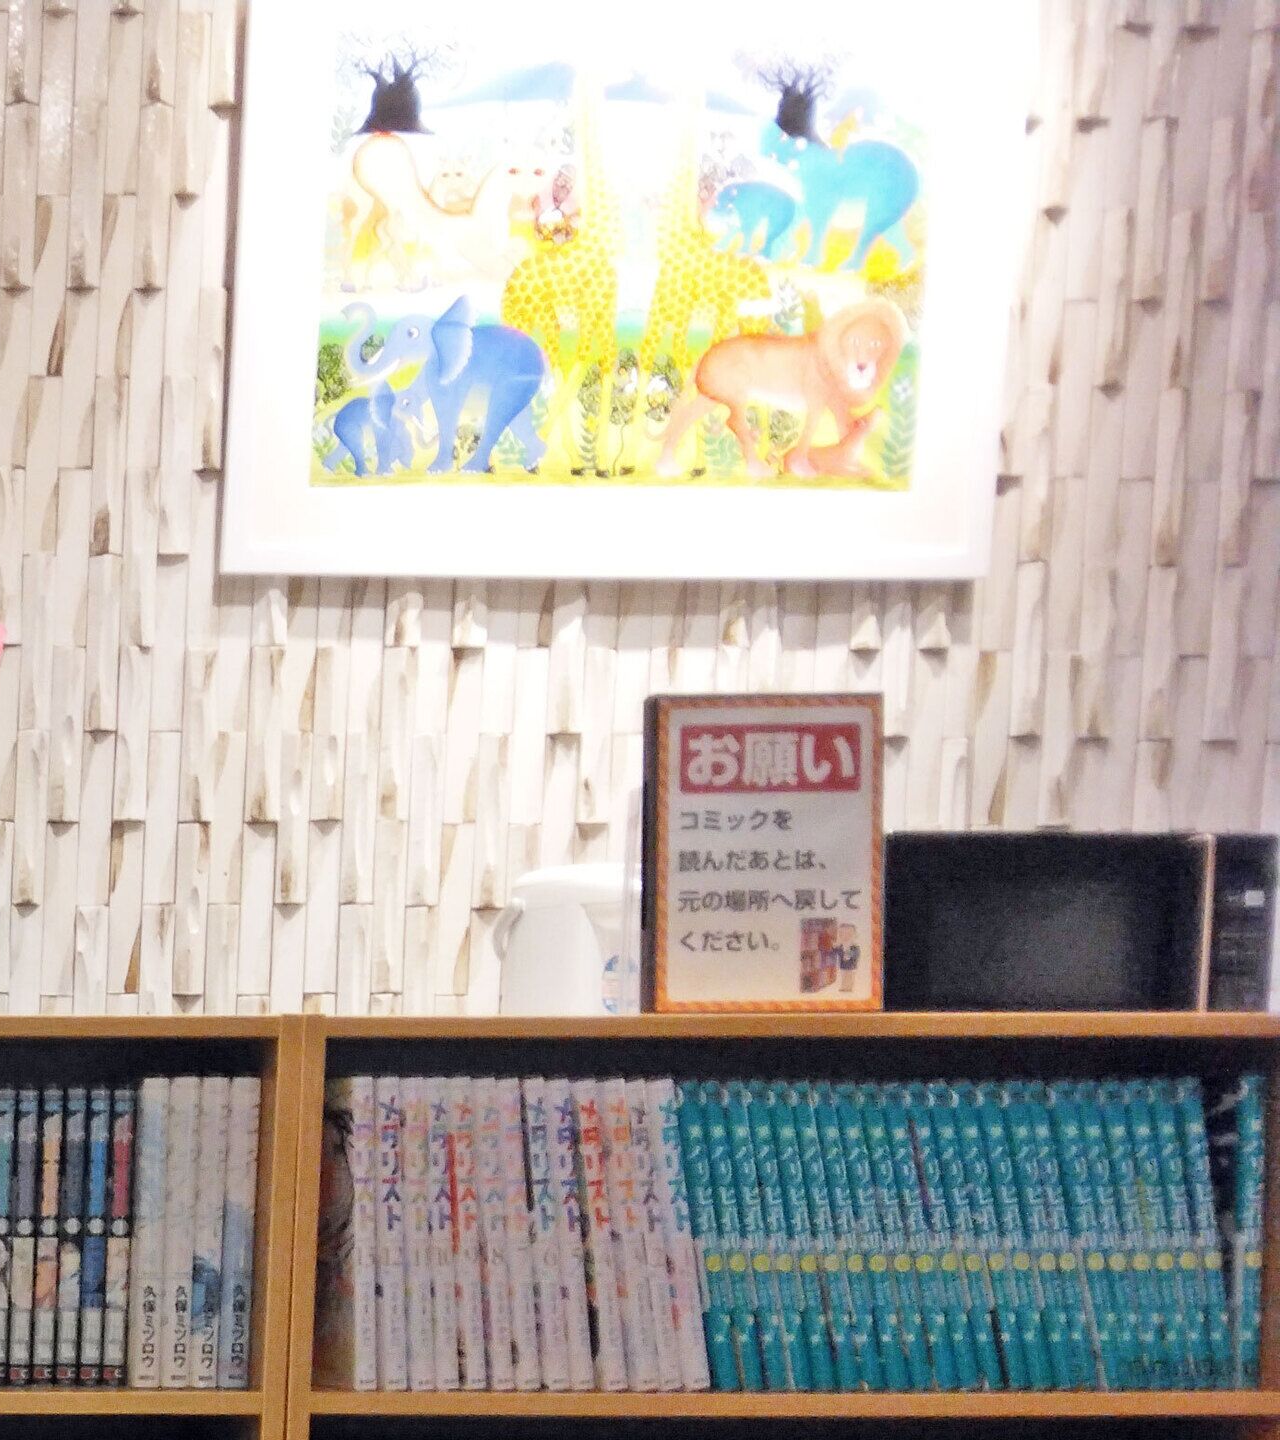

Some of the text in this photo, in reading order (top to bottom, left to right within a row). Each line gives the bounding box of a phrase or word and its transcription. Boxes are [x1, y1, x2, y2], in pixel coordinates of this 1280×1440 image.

[686, 733, 856, 786] お願い
[680, 810, 793, 832] コミックを
[678, 851, 826, 872] 読んだあとは、
[678, 889, 862, 913] 元の場所へ戻して
[680, 931, 780, 952] ください。
